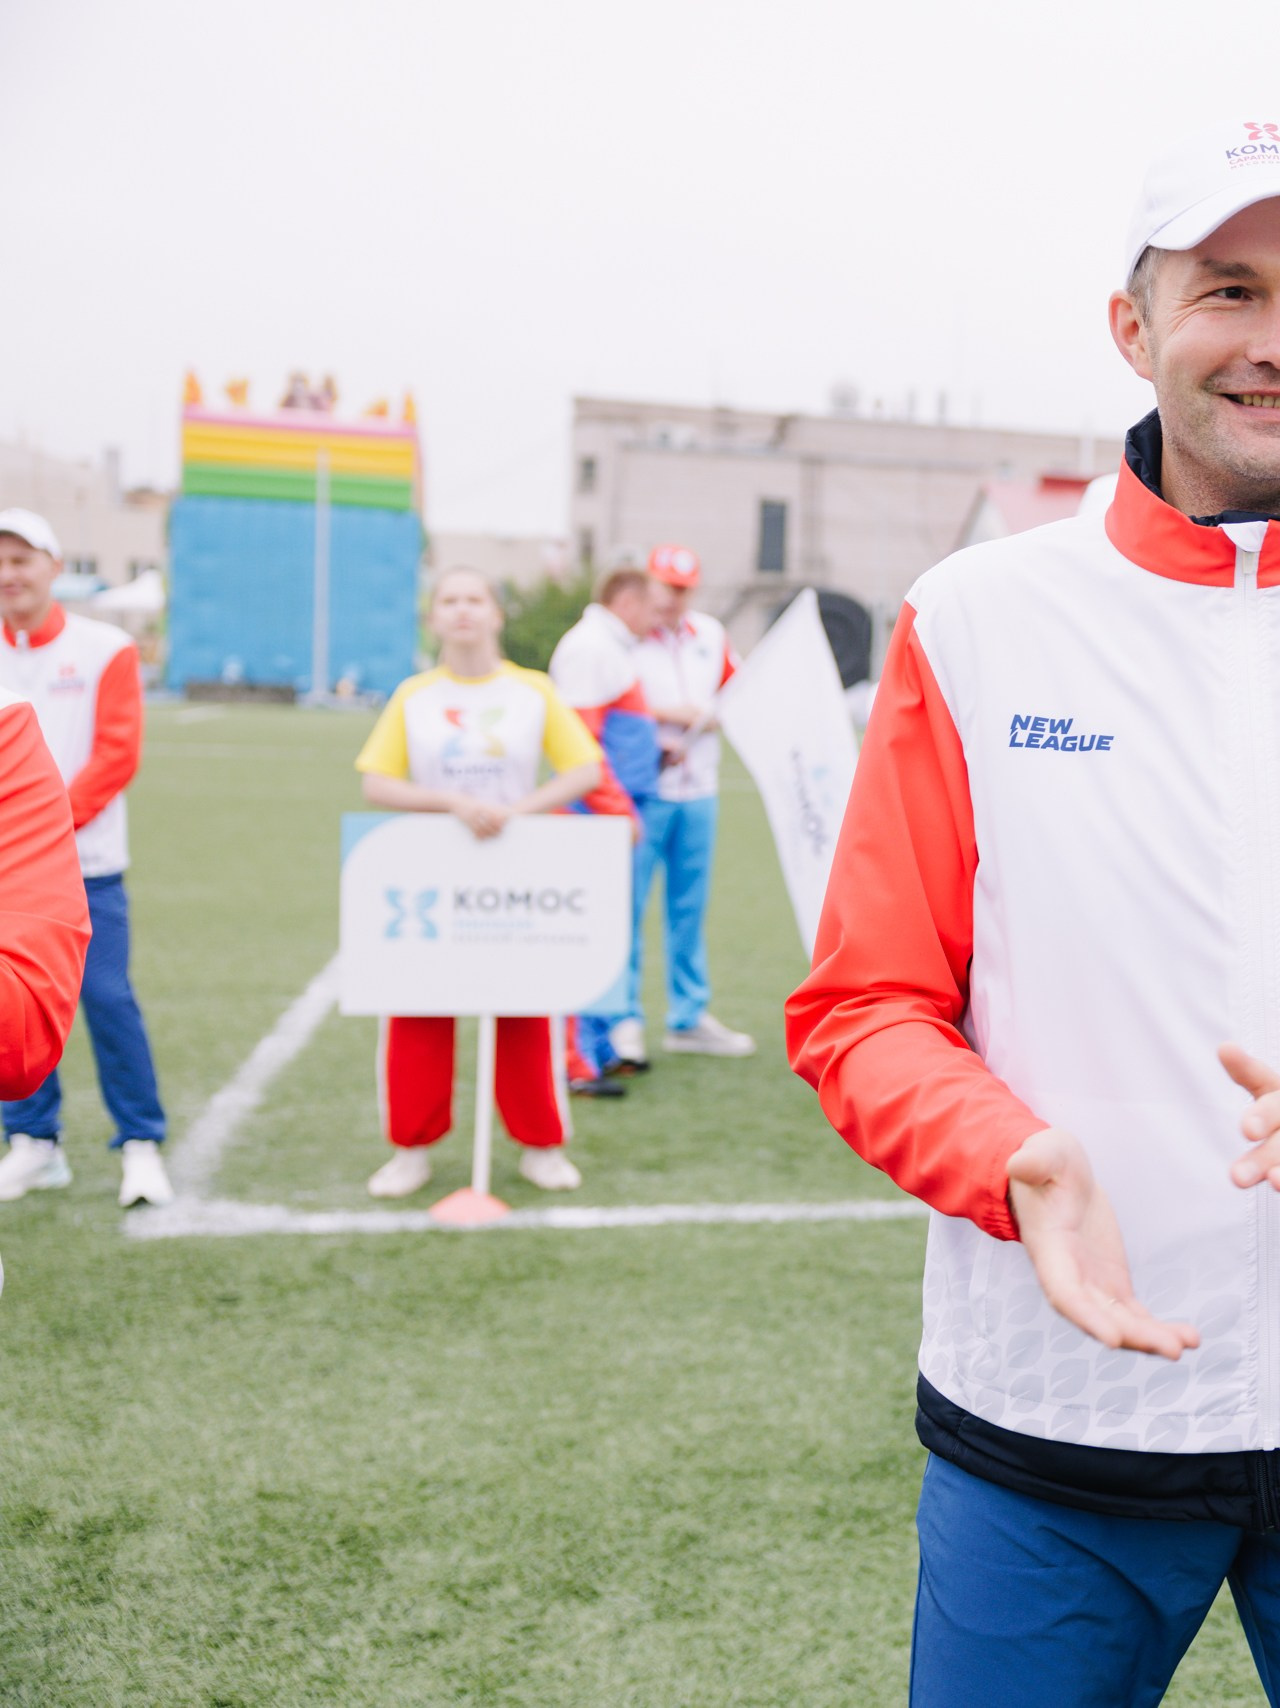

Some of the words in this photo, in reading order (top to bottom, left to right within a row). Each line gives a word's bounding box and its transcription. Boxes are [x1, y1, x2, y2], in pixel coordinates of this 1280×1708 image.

[1010, 714, 1074, 736] NEW
[1009, 731, 1114, 752] LEAGUE
[453, 887, 586, 915] КОМОС
